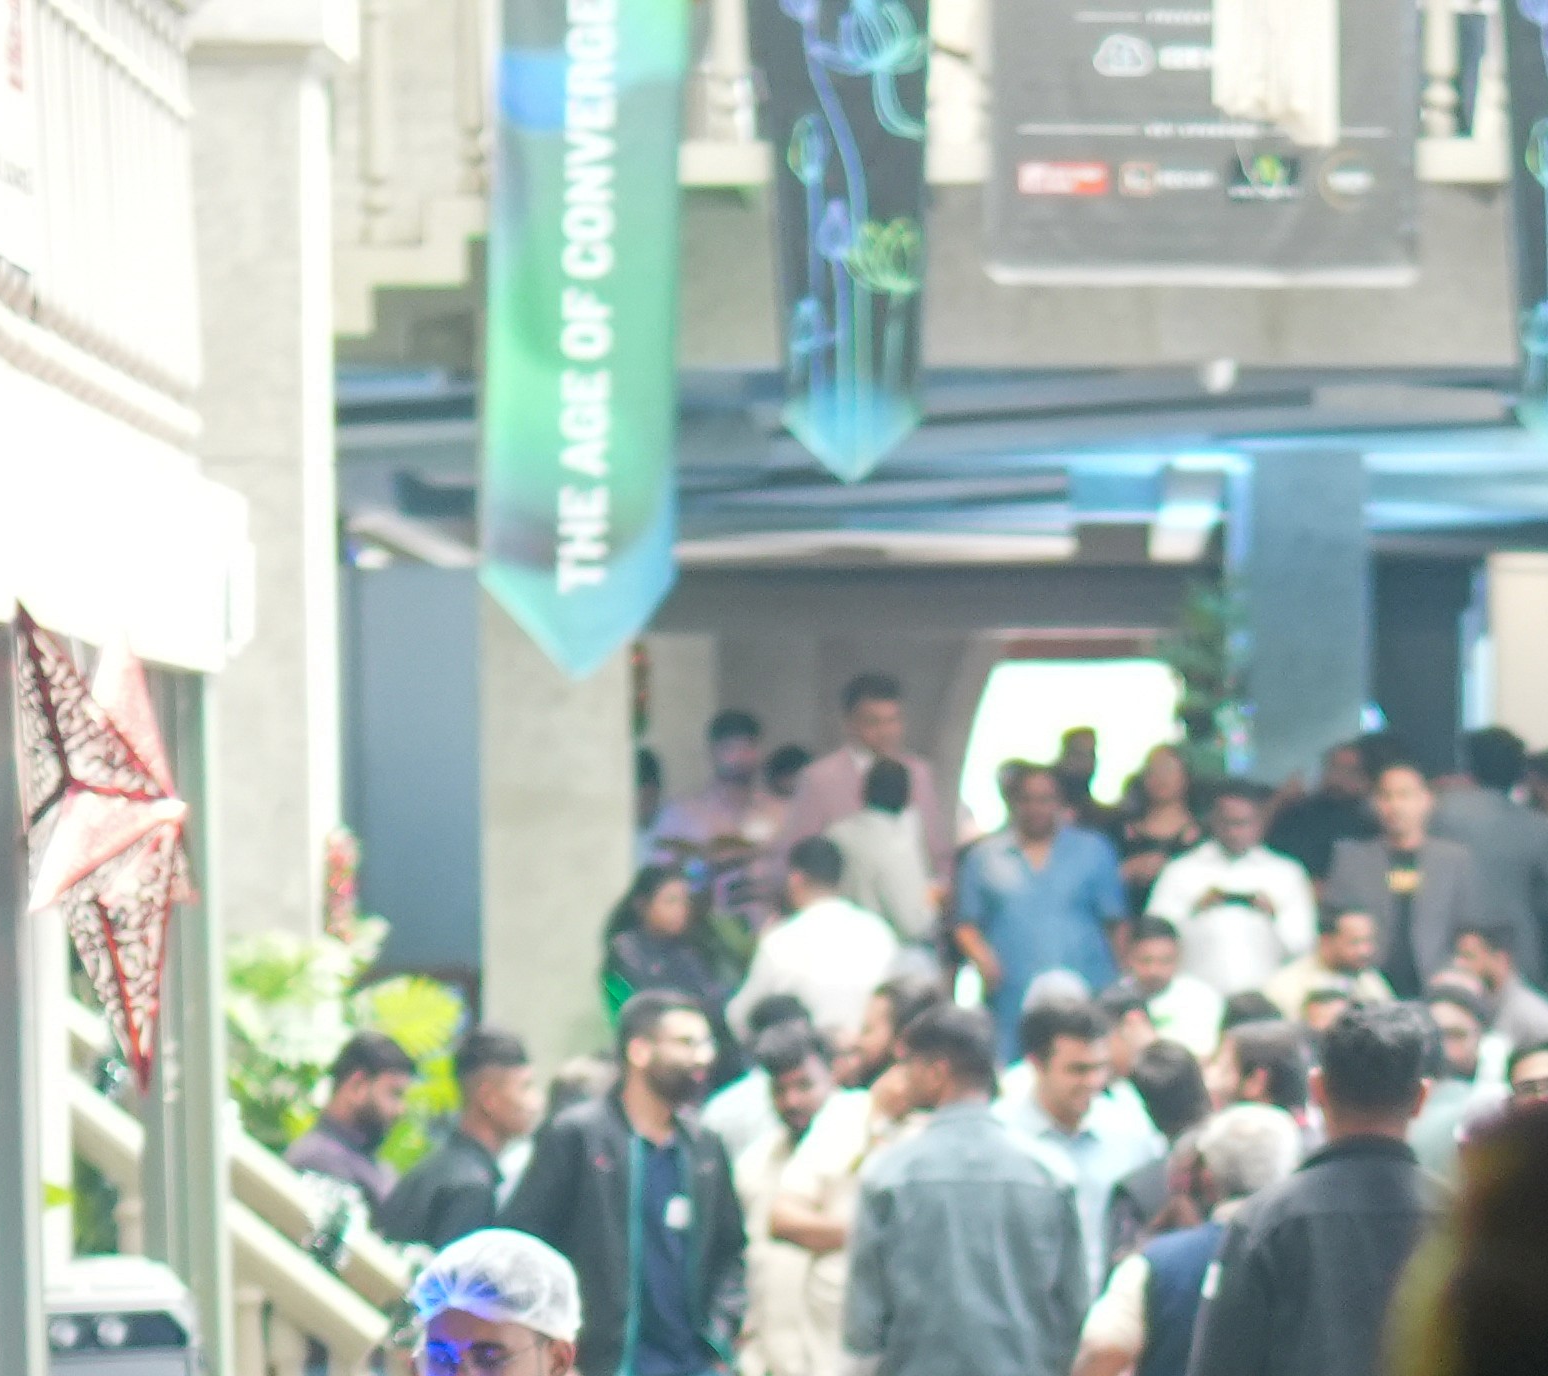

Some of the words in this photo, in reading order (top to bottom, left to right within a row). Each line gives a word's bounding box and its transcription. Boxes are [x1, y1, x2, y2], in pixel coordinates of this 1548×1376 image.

[561, 292, 614, 362] OF
[558, 371, 612, 479] AGE
[556, 486, 610, 597] THE
